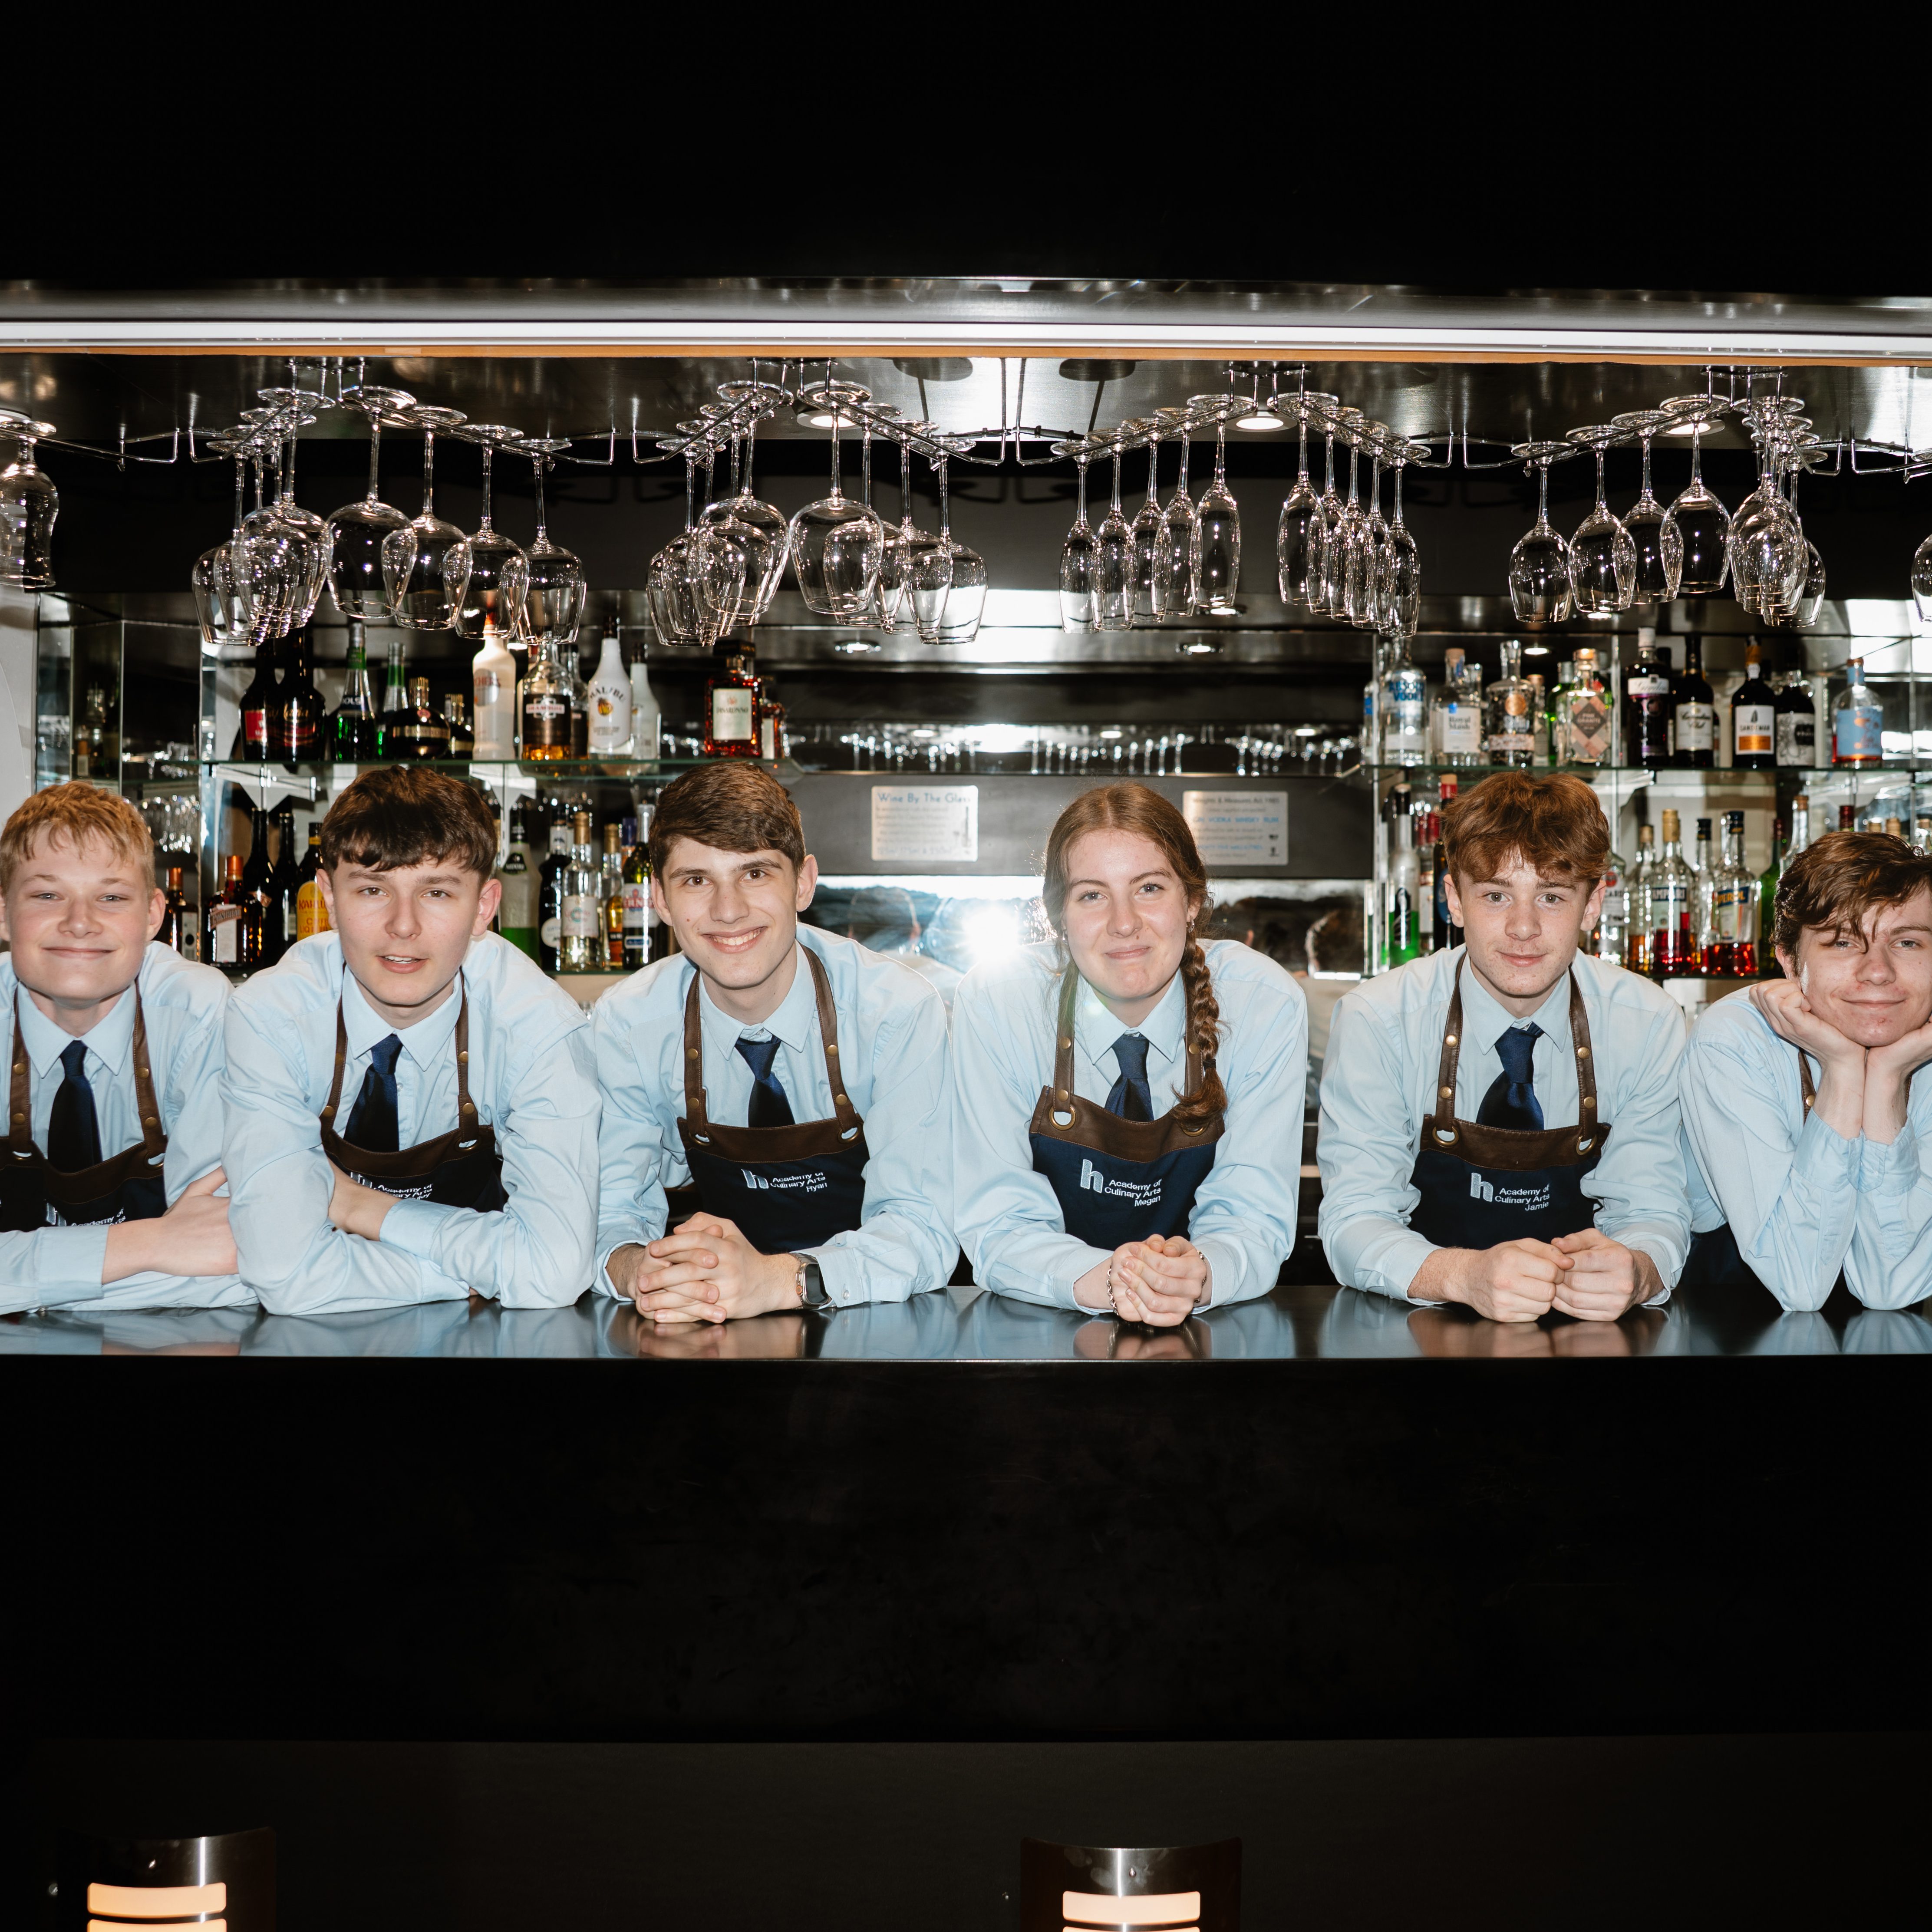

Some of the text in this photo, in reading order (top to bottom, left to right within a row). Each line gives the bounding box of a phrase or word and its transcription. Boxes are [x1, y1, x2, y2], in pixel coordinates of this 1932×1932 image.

[590, 686, 627, 703] MALIBU
[877, 792, 903, 802] Wine
[907, 792, 919, 804] By
[924, 792, 941, 802] The
[1652, 888, 1685, 900] AMPRI
[1718, 890, 1745, 905] PEROL
[773, 1174, 812, 1183] Academy
[807, 1176, 826, 1185] Arts
[1109, 1178, 1163, 1191] Academy of
[806, 1182, 828, 1192] Ryan
[1104, 1187, 1161, 1199] Culinary Arts
[1543, 1183, 1550, 1193] of
[1134, 1195, 1161, 1207] Megan
[1494, 1193, 1550, 1204] Culinary Arts
[1524, 1200, 1549, 1211] Jamie
